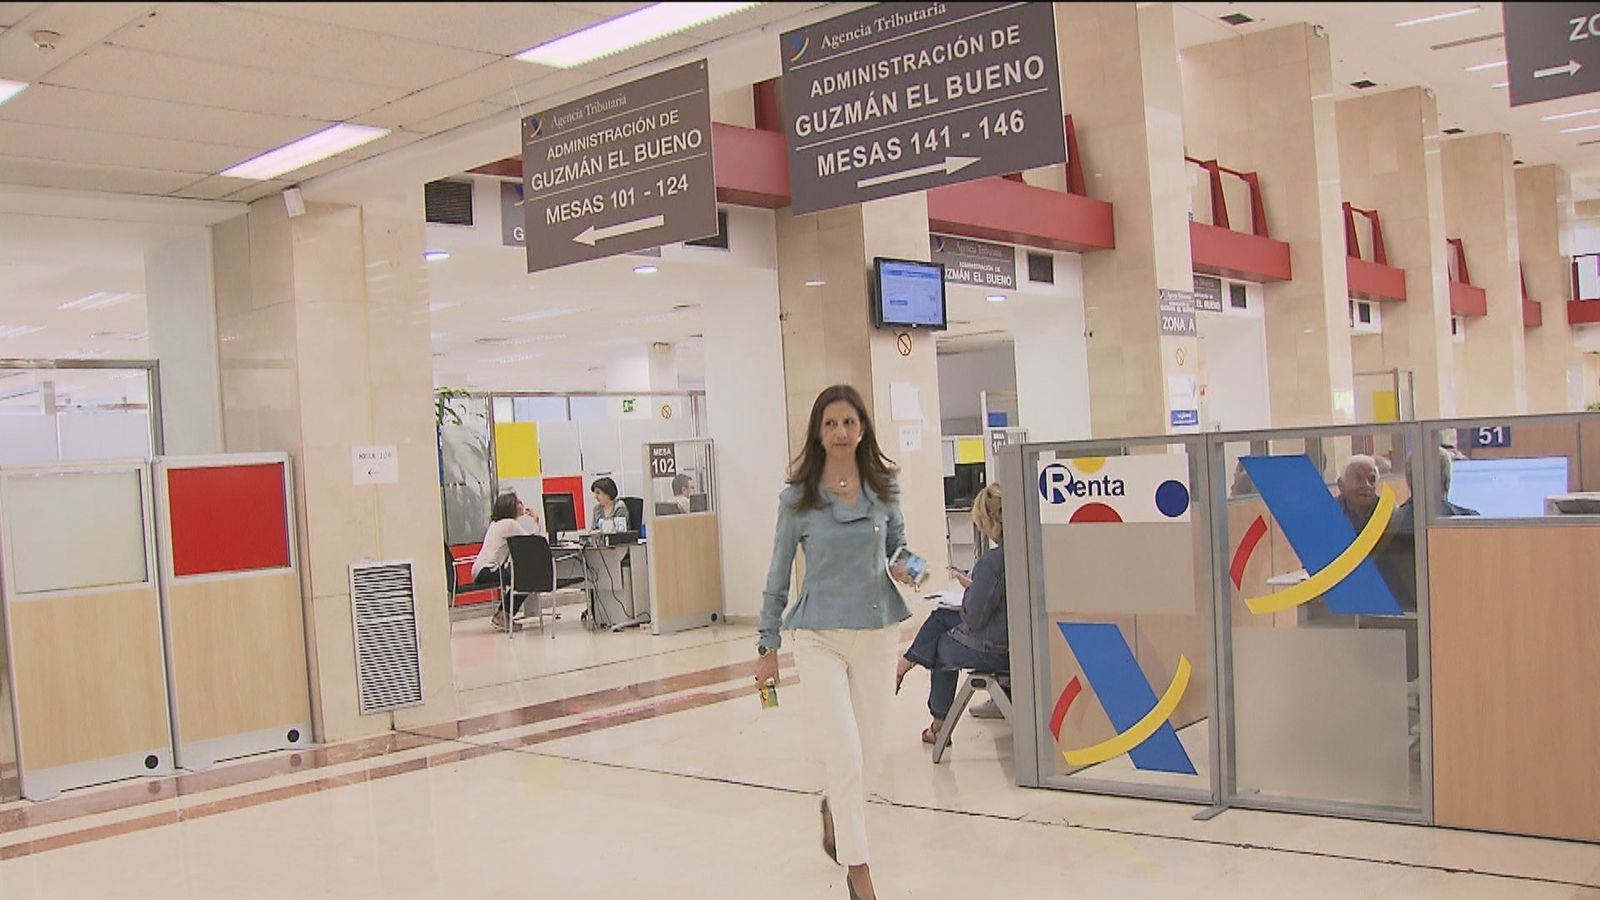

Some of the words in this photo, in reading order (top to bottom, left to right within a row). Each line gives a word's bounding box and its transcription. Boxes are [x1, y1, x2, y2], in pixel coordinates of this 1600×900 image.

[821, 24, 872, 49] Agencia
[873, 3, 947, 34] Tributaria
[810, 34, 984, 98] ADMINISTRACIÓN
[991, 24, 1021, 50] DE
[551, 108, 584, 128] Agencia
[585, 94, 628, 117] Tributaria
[795, 91, 899, 137] GUZMÁN
[906, 83, 939, 111] EL
[946, 55, 1045, 101] BUENO
[547, 117, 656, 160] ADMINISTRACIÓN
[659, 109, 680, 127] DE
[817, 136, 902, 178] MESAS
[910, 125, 951, 156] 141
[961, 130, 971, 140] -
[978, 109, 1025, 141] 146
[531, 156, 603, 191] GUZMÁN
[608, 149, 631, 170] EL
[634, 128, 702, 163] BUENO
[546, 194, 605, 225] MESAS
[610, 187, 636, 209] 101
[656, 173, 689, 198] 124
[973, 271, 984, 283] EL
[986, 273, 1012, 287] BUENO
[1162, 316, 1186, 332] ZONA
[1188, 318, 1195, 332] A
[1479, 426, 1504, 445] 51
[652, 458, 675, 474] 102
[1045, 465, 1126, 503] Renta
